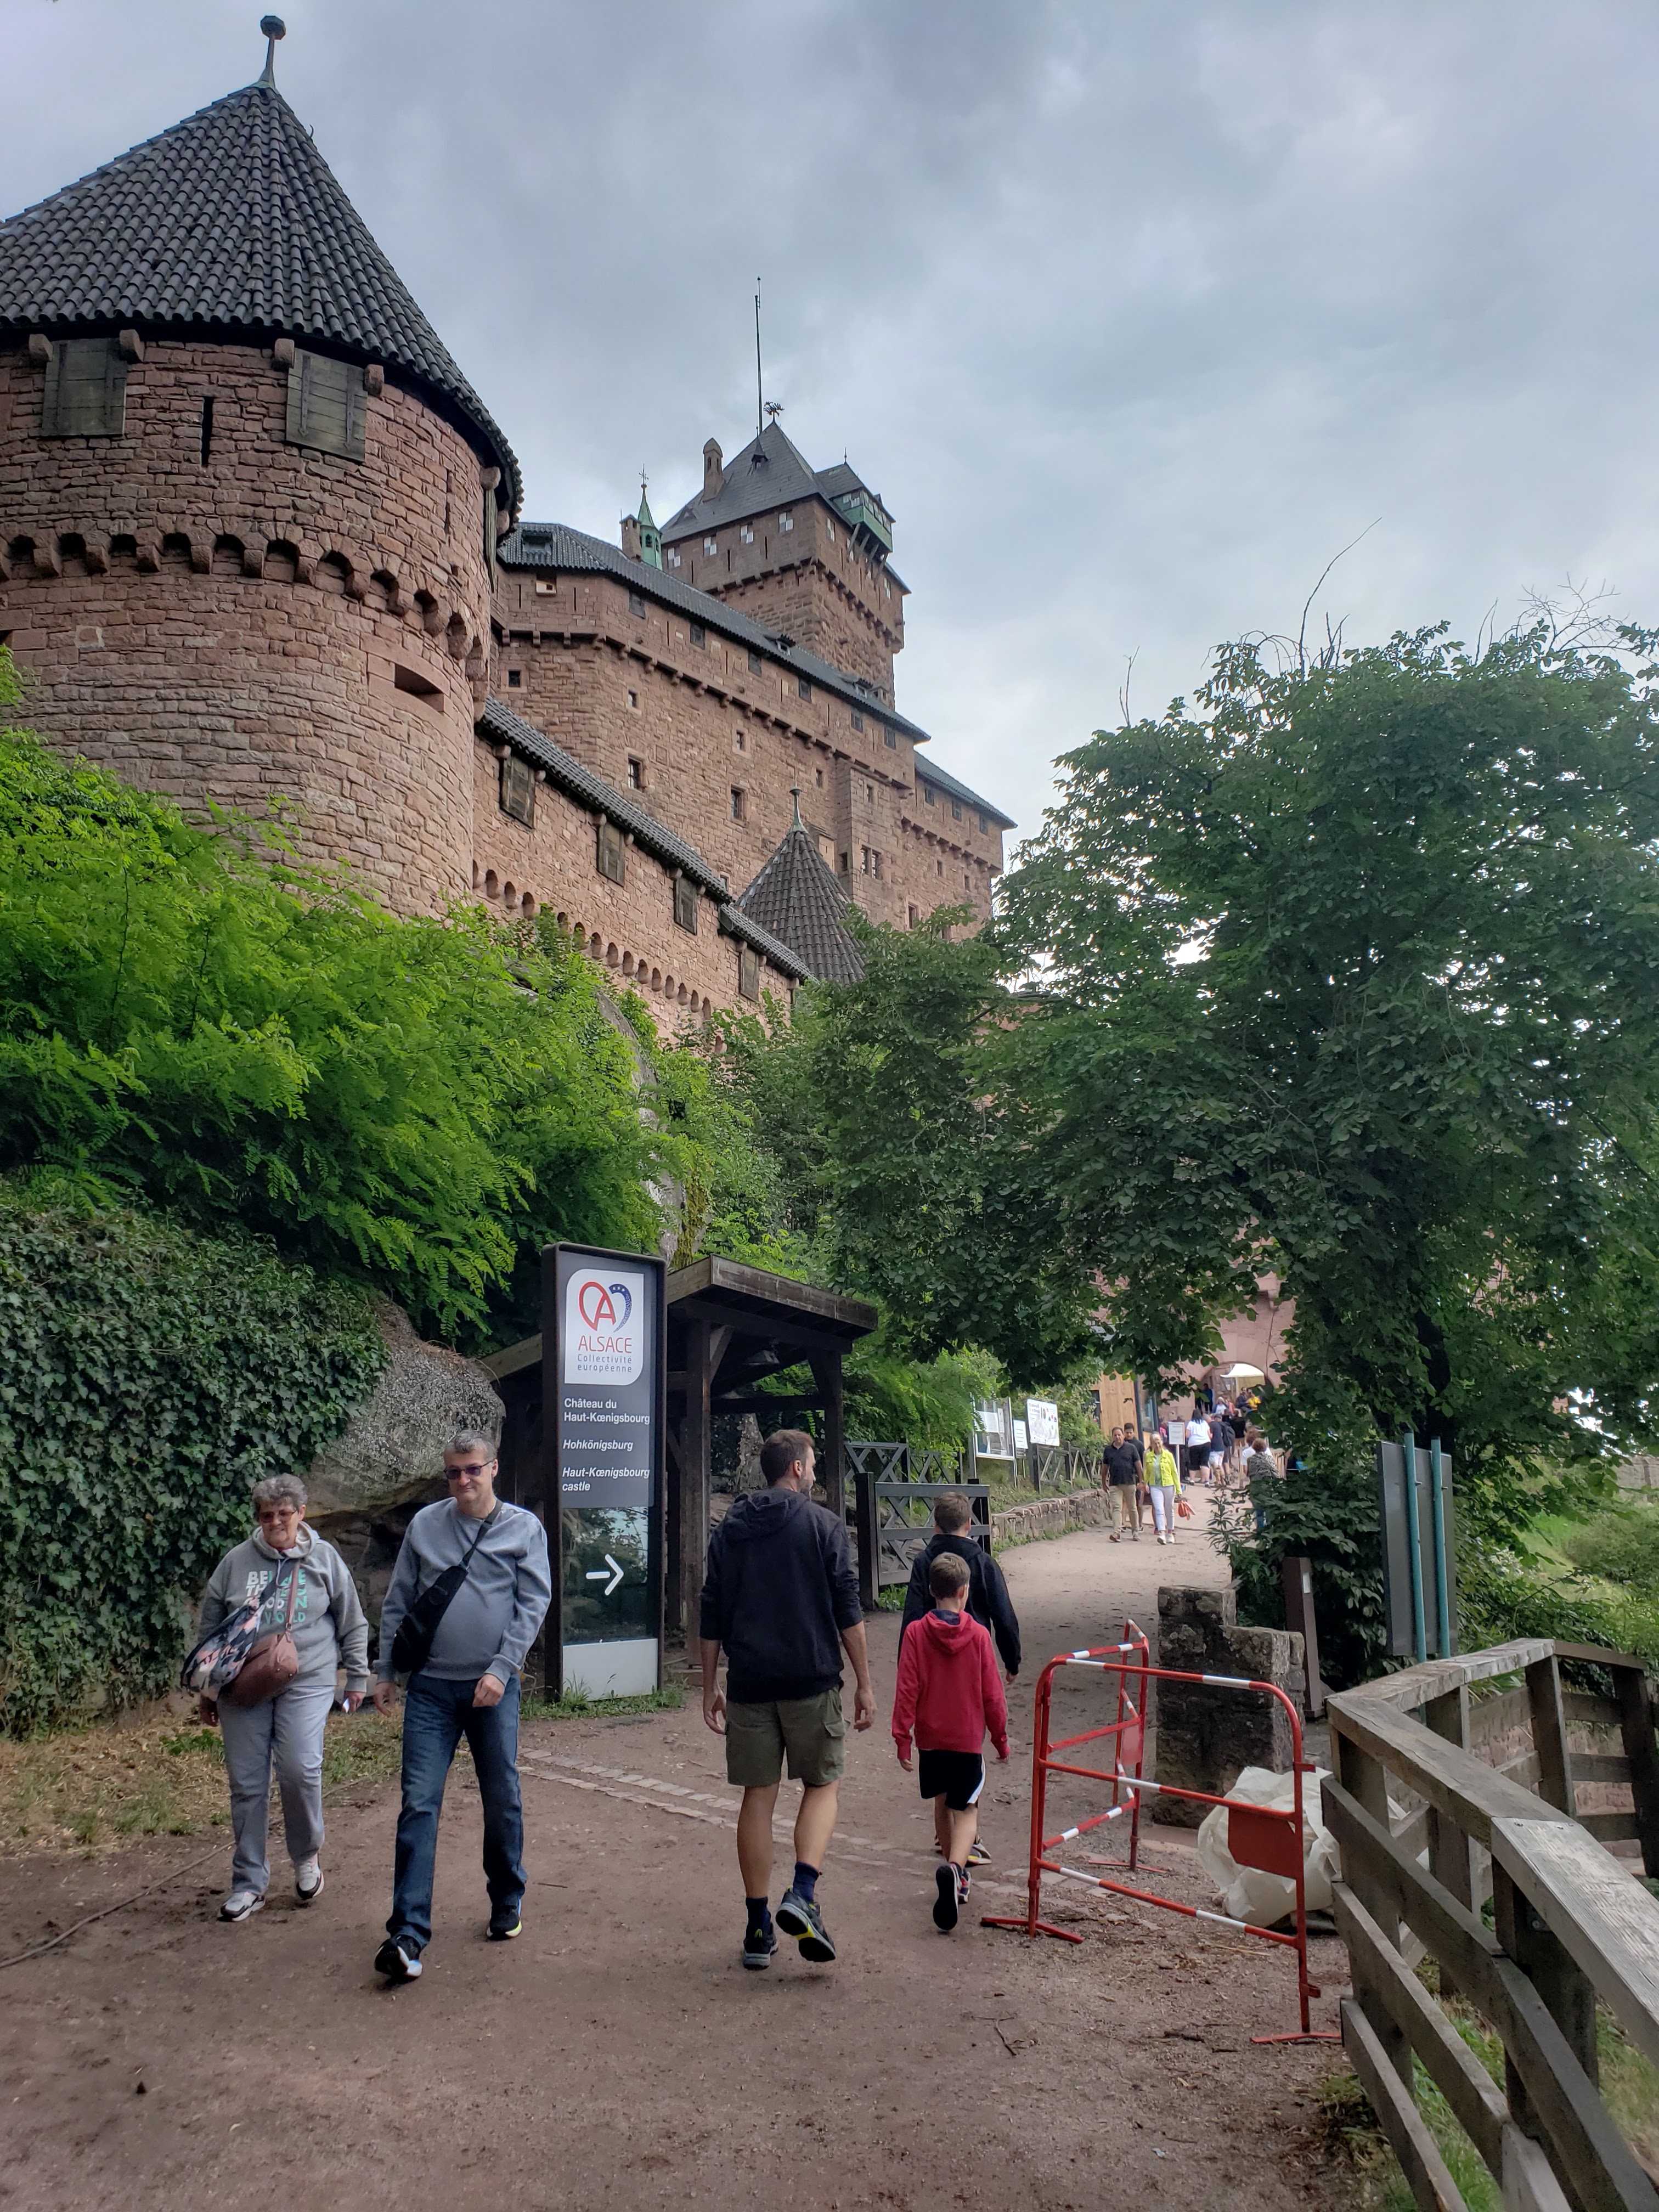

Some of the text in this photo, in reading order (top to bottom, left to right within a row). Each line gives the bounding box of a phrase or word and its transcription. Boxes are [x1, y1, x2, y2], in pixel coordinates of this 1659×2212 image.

[578, 1335, 632, 1353] ALSACE
[578, 1353, 631, 1364] Collectivité
[577, 1363, 631, 1373] européenne
[564, 1398, 617, 1409] Château du
[564, 1412, 650, 1425] Haut-Kœnigsbourg
[563, 1439, 633, 1452] Hohkönigsburg
[562, 1467, 650, 1479] Haut-Kœnigsbourg
[562, 1481, 591, 1491] castle
